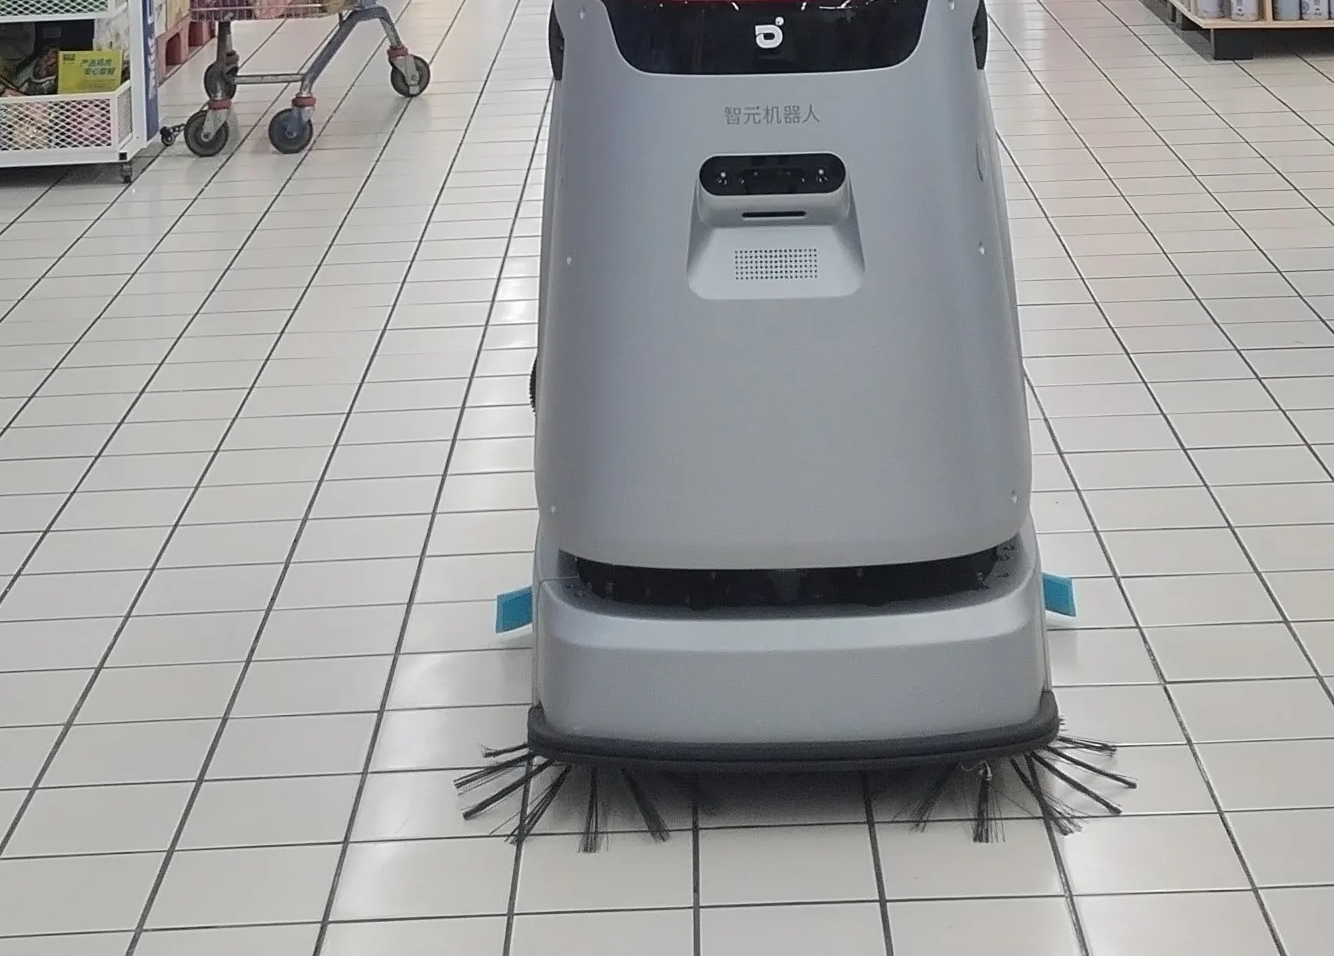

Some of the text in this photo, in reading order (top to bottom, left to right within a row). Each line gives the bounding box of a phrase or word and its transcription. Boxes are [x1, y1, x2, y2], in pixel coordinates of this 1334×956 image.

[723, 105, 821, 125] 智元机器人
